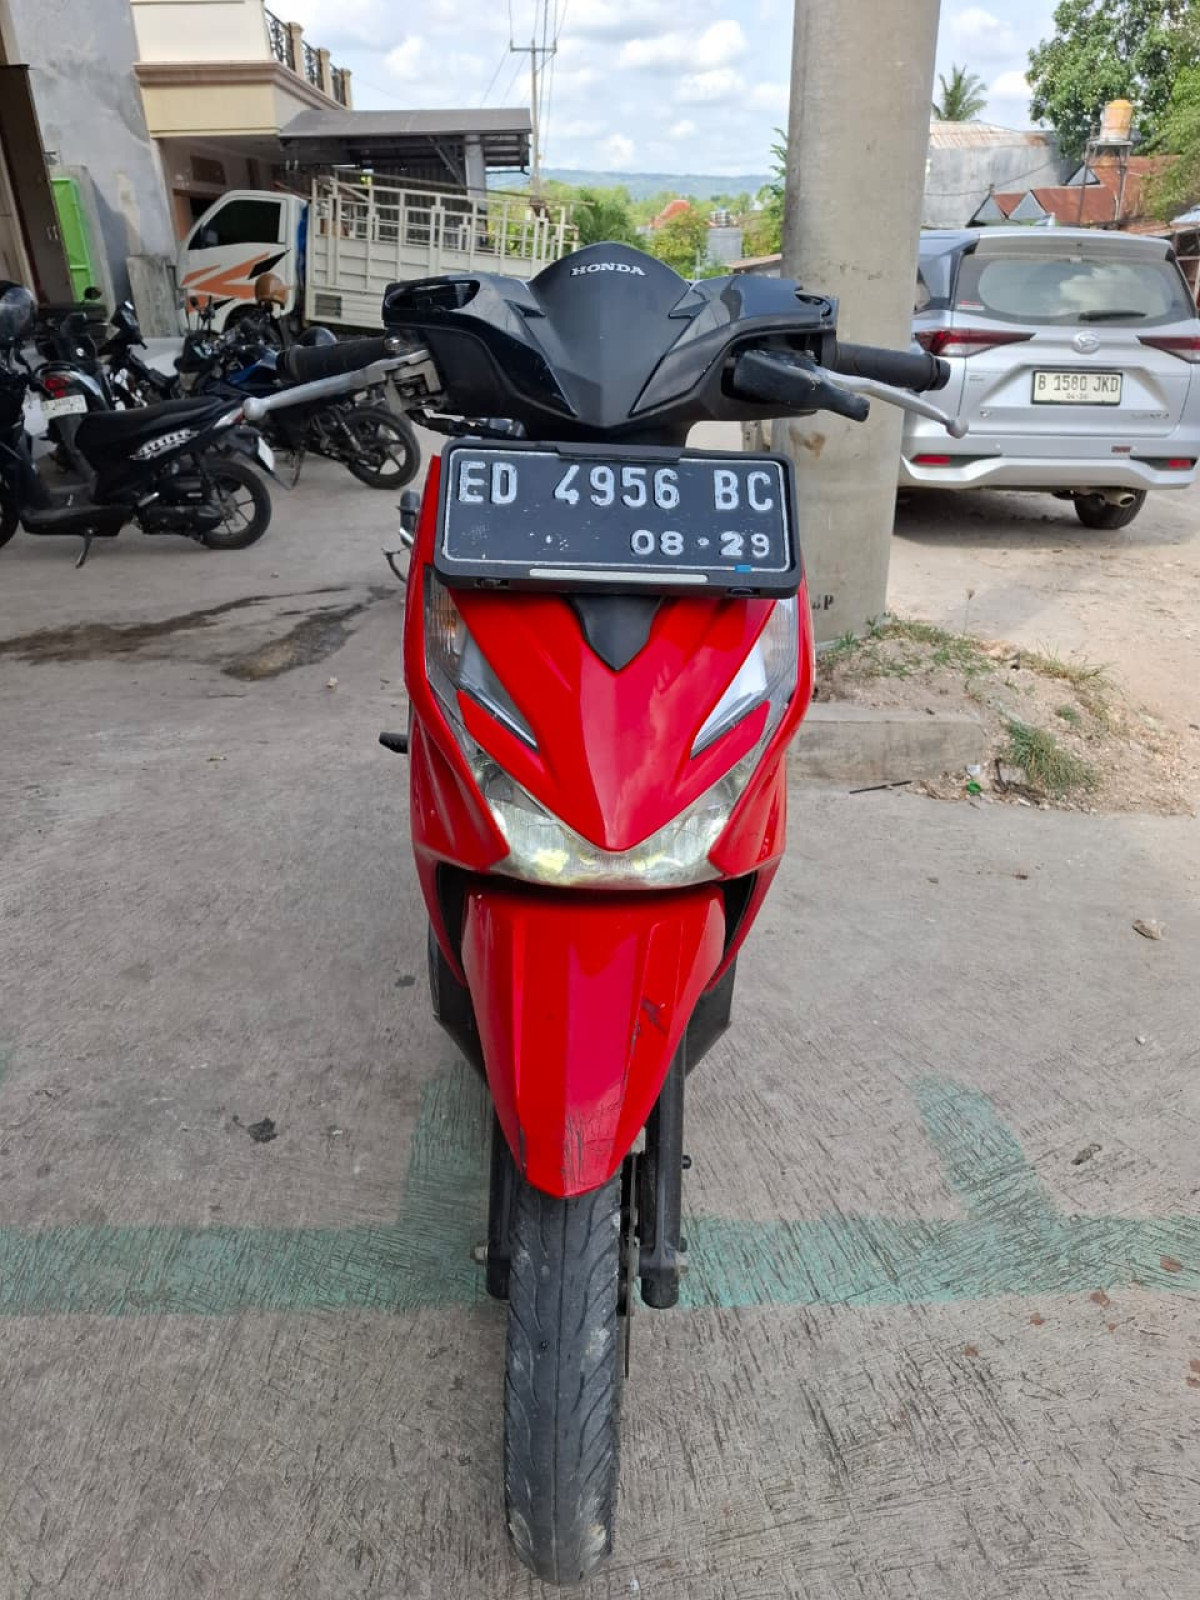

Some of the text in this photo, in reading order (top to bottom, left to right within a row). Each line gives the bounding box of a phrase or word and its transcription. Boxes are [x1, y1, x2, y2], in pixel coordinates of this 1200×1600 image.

[569, 262, 646, 276] HONDA
[1038, 375, 1119, 392] B 1580 JKD
[458, 460, 773, 512] ED 4956 BC
